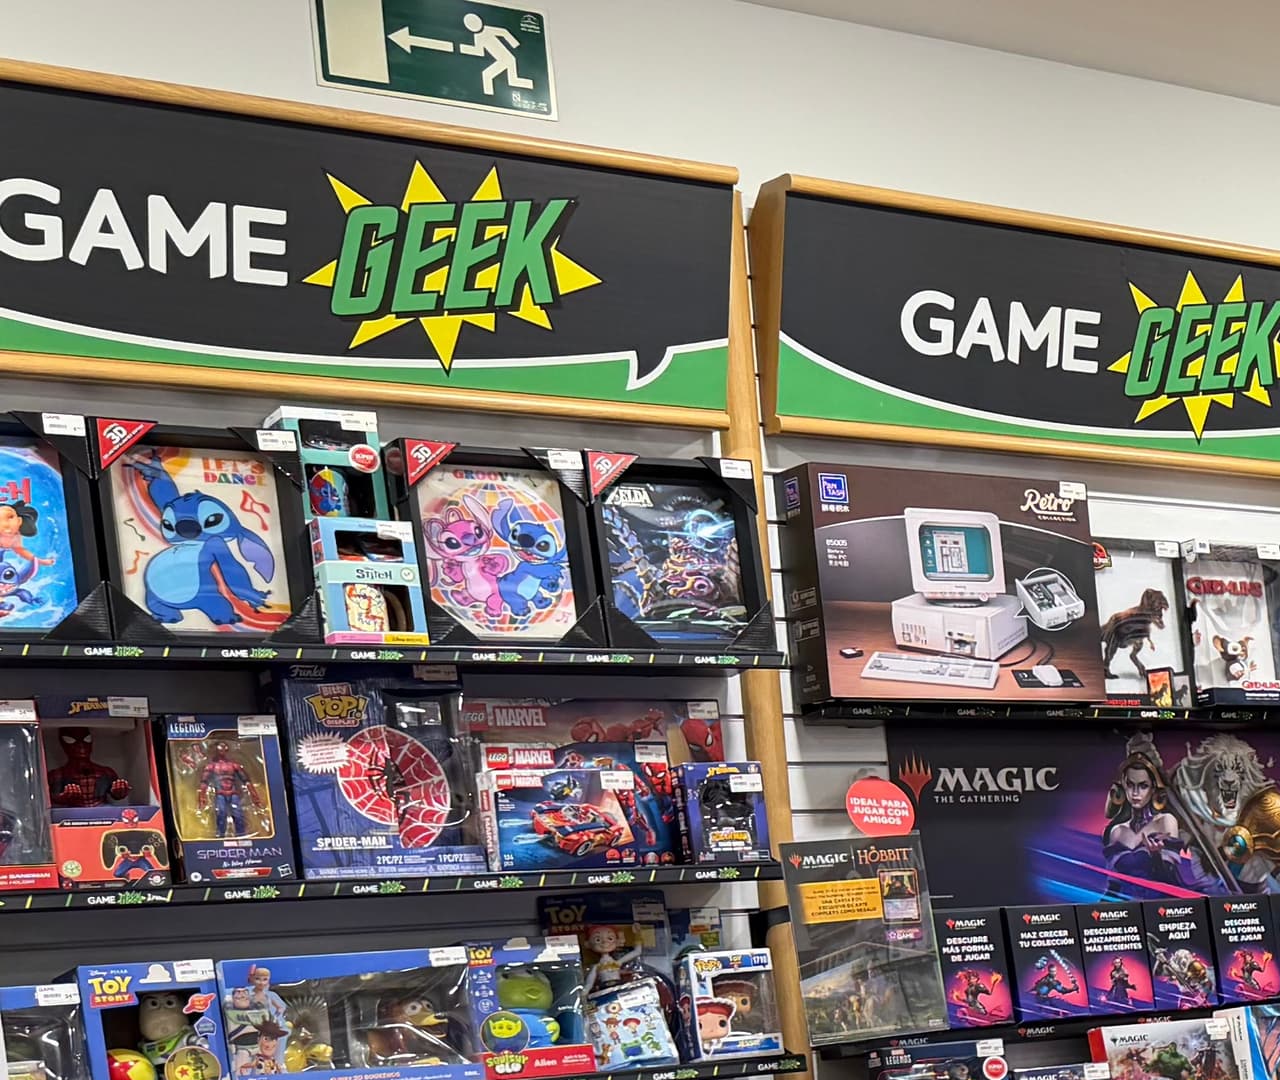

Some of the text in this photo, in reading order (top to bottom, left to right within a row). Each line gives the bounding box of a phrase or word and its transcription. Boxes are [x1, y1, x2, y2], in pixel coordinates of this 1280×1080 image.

[0, 178, 574, 316] GAME GEEK
[900, 290, 1100, 374] GAME
[934, 768, 1060, 792] MAGIC
[850, 797, 908, 812] IDEAL PARA
[934, 794, 1020, 803] THE GATHERING
[853, 806, 909, 818] JUGAR CON
[316, 836, 386, 848] SPIDER-MAN
[1158, 922, 1197, 932] EMPIEZA
[946, 935, 988, 946] DESCUBRE
[942, 944, 994, 954] MÁS FORMAS
[951, 952, 990, 962] DE JUGAR
